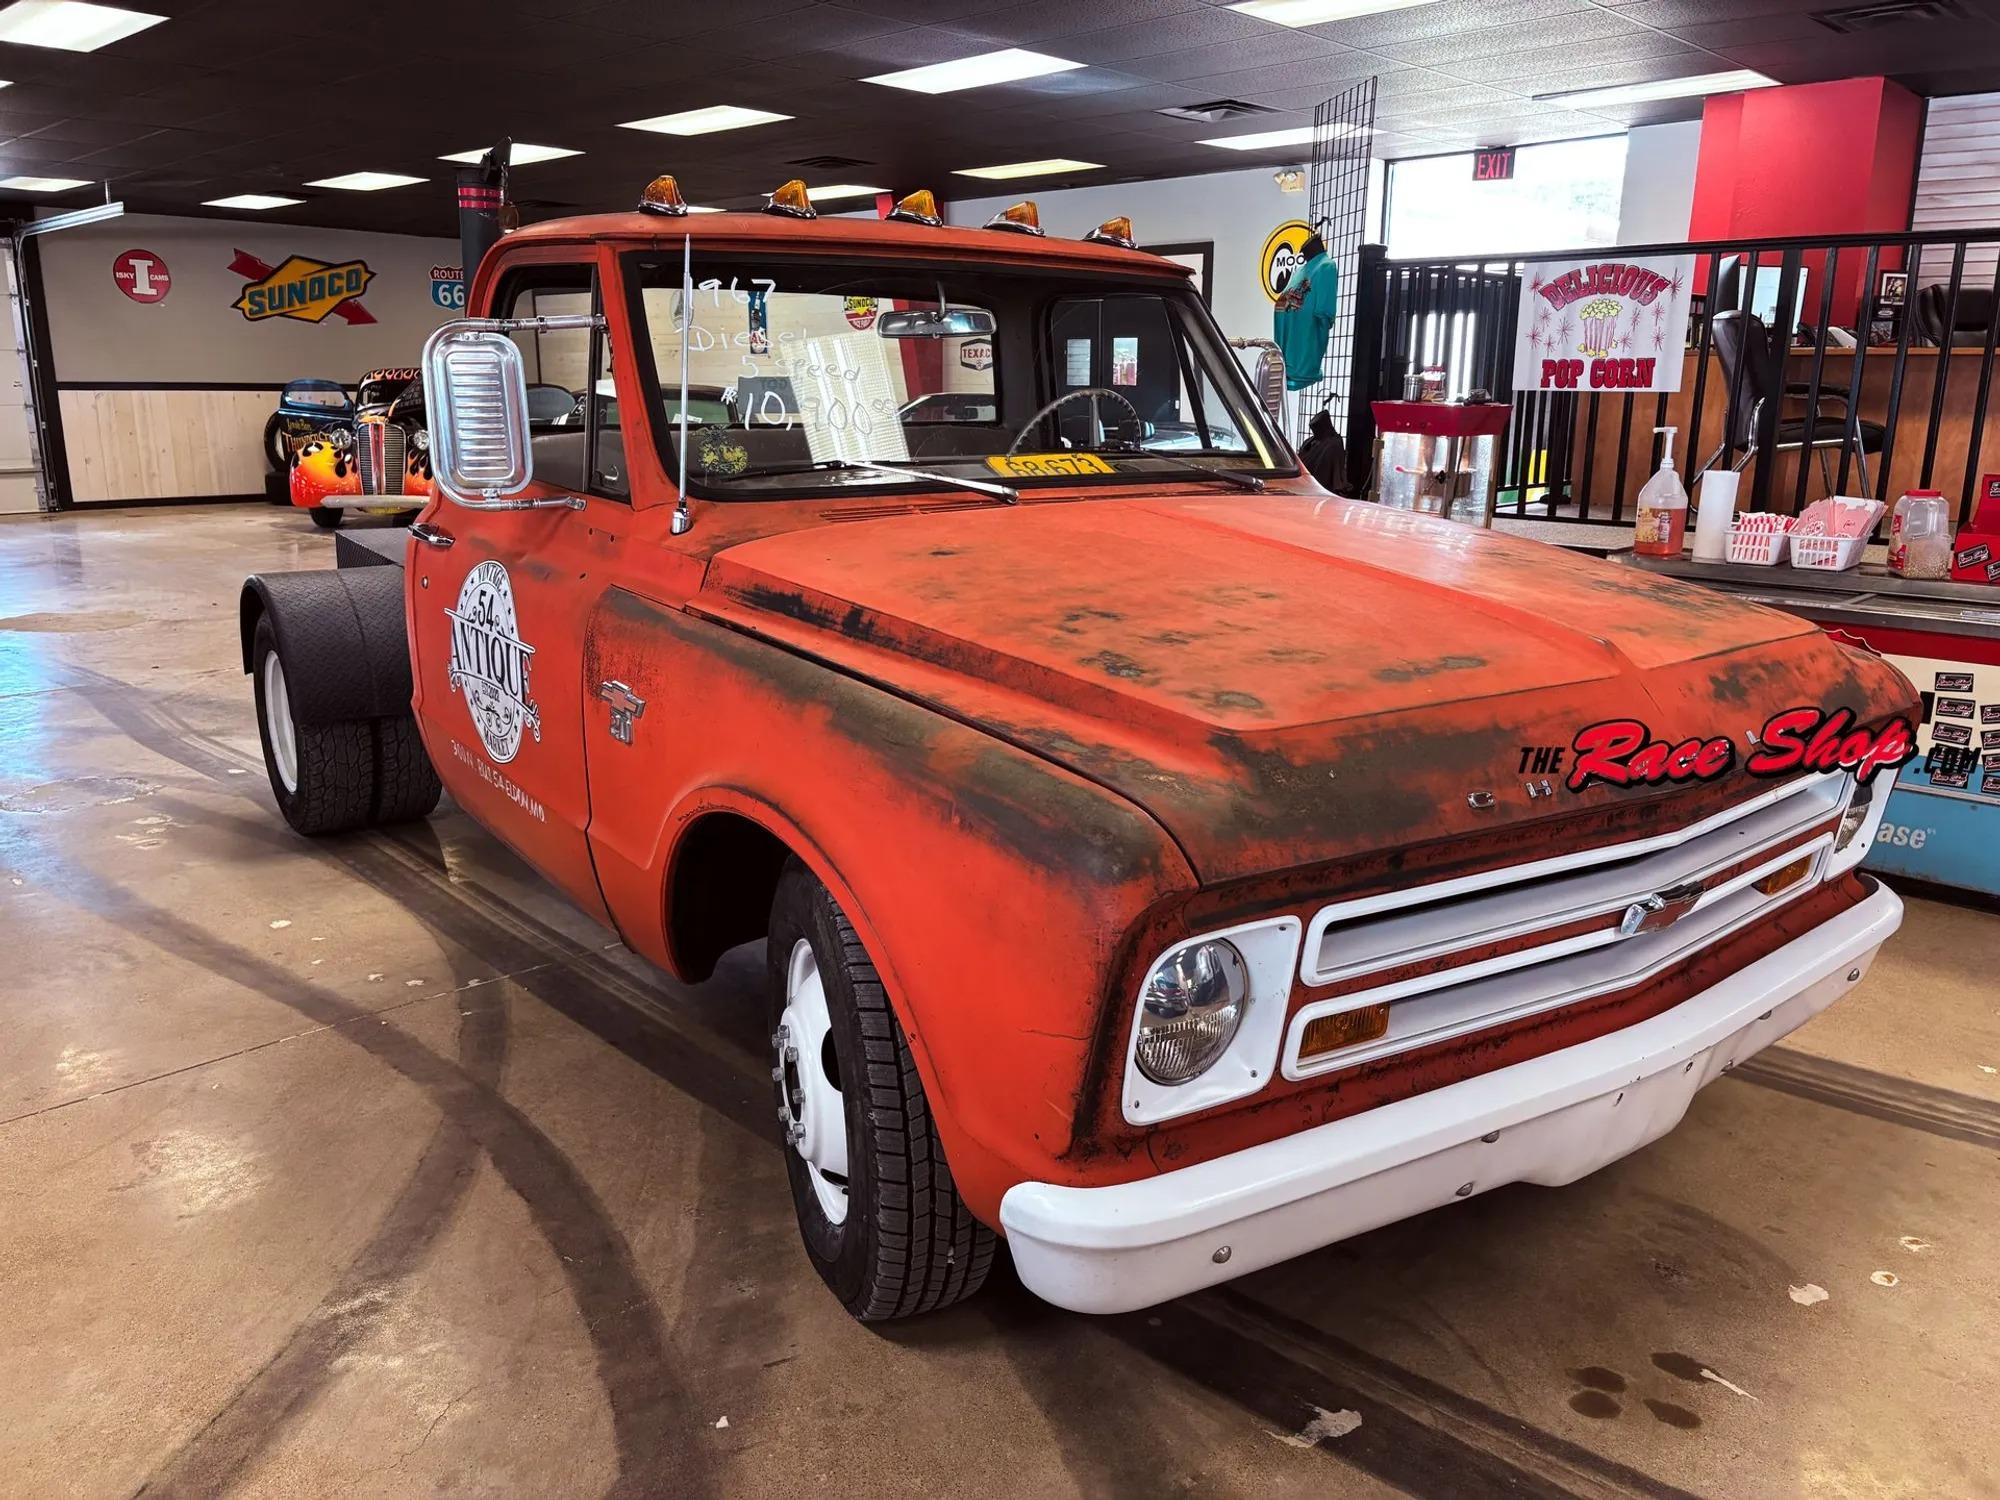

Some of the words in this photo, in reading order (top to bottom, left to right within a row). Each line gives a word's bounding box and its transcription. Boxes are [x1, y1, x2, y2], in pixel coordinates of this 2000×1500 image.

[1477, 152, 1511, 179] EXIT
[1276, 254, 1306, 267] MOO
[115, 271, 135, 280] ISKY
[149, 274, 169, 282] CAMS
[1538, 263, 1672, 311] DELICIOUS
[248, 268, 362, 316] SUNOCO
[438, 284, 465, 306] 66
[674, 326, 807, 352] Diesel
[962, 347, 992, 359] TEXAC
[739, 355, 759, 379] 5
[1540, 358, 1584, 388] POP
[1590, 357, 1656, 388] CORN
[477, 563, 506, 592] VINTAGE
[477, 589, 495, 632] 54
[452, 621, 532, 704] ANTIQUE
[483, 725, 510, 757] MARKET
